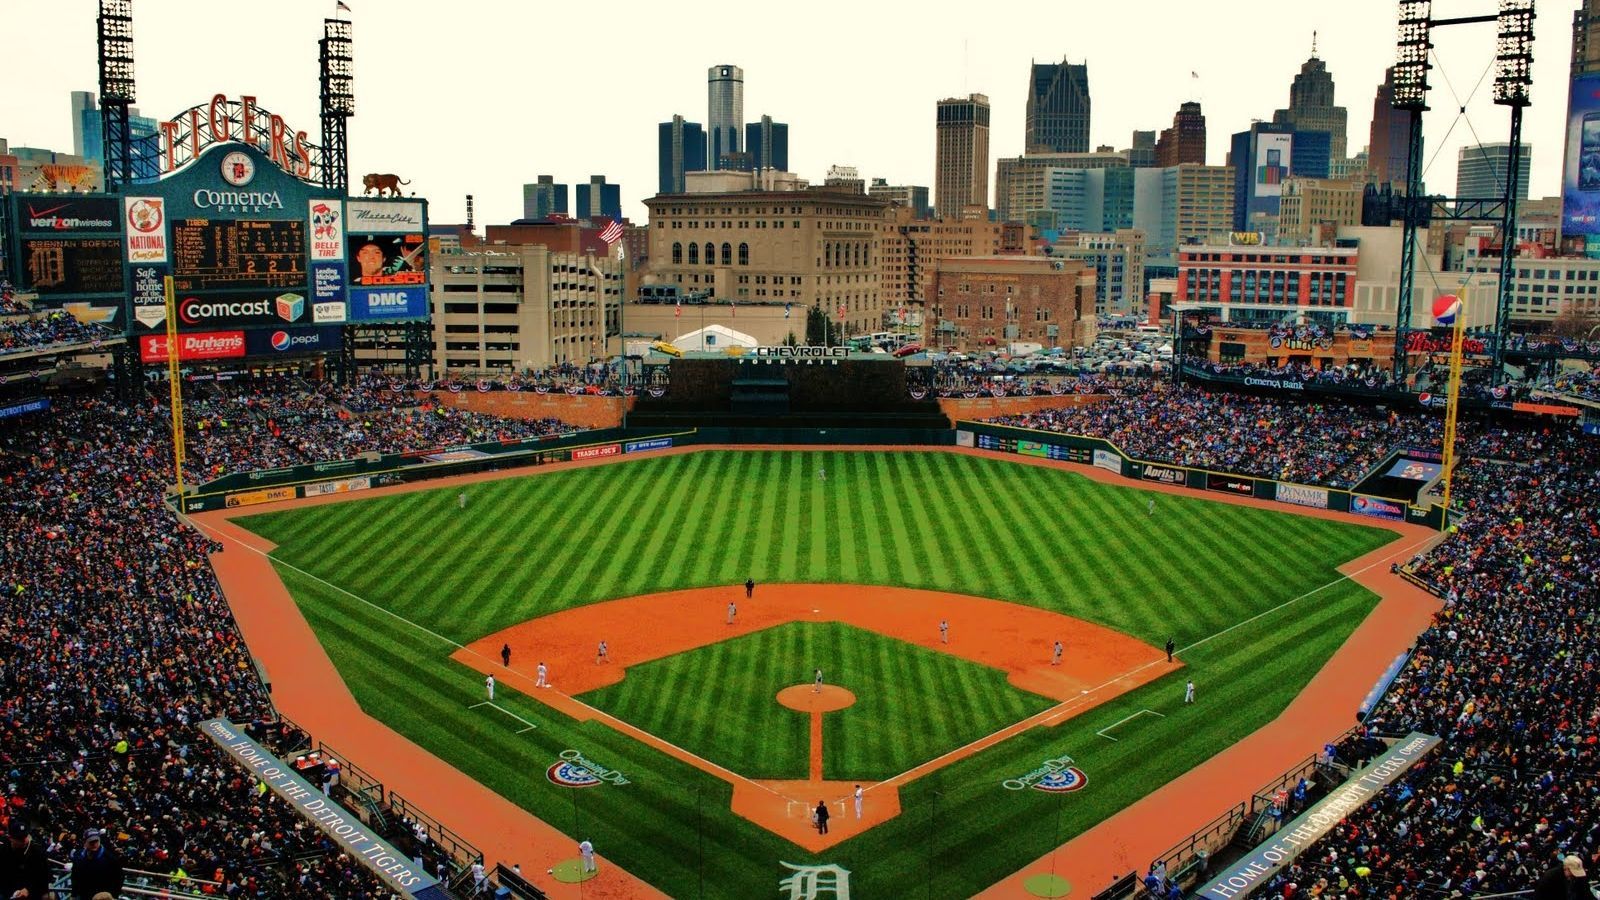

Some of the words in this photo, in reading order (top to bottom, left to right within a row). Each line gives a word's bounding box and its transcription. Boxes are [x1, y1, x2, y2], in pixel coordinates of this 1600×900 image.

[160, 93, 311, 177] TIGERS
[29, 240, 76, 248] BRENNAN
[82, 240, 121, 248] BOESCH
[130, 235, 165, 250] NATIONAL
[1234, 231, 1260, 245] WJR
[314, 242, 340, 250] BELLE
[318, 249, 337, 257] TIRE
[247, 260, 256, 273] 2
[269, 260, 278, 273] 2
[291, 260, 299, 273] 1
[136, 267, 157, 279] Safe
[136, 281, 163, 291] home
[134, 295, 166, 305] experts
[368, 292, 408, 306] DMC
[185, 335, 243, 350] Dunham's
[291, 333, 319, 348] pepsi
[757, 346, 852, 357] CHEVROLET
[1283, 381, 1305, 390] Bank
[22, 402, 41, 412] TIGERS
[577, 449, 600, 458] TRADER
[319, 482, 337, 494] TASTE
[1227, 482, 1251, 491] verizon
[1281, 484, 1326, 500] DYNAMIC
[267, 490, 288, 499] DMC
[1372, 502, 1401, 514] TOTAL
[1043, 755, 1075, 771] Day
[600, 770, 631, 785] Day
[231, 741, 264, 769] HOME
[263, 766, 287, 785] OF
[280, 779, 310, 799] THE
[303, 799, 369, 845] DETROIT
[361, 843, 421, 887] TIGERS
[1211, 862, 1269, 899] HOME
[1263, 844, 1289, 862] OF
[1282, 822, 1312, 846] THE
[1309, 783, 1370, 827] DETROIT
[1360, 756, 1407, 788] TIGERS
[779, 860, 852, 900] D
